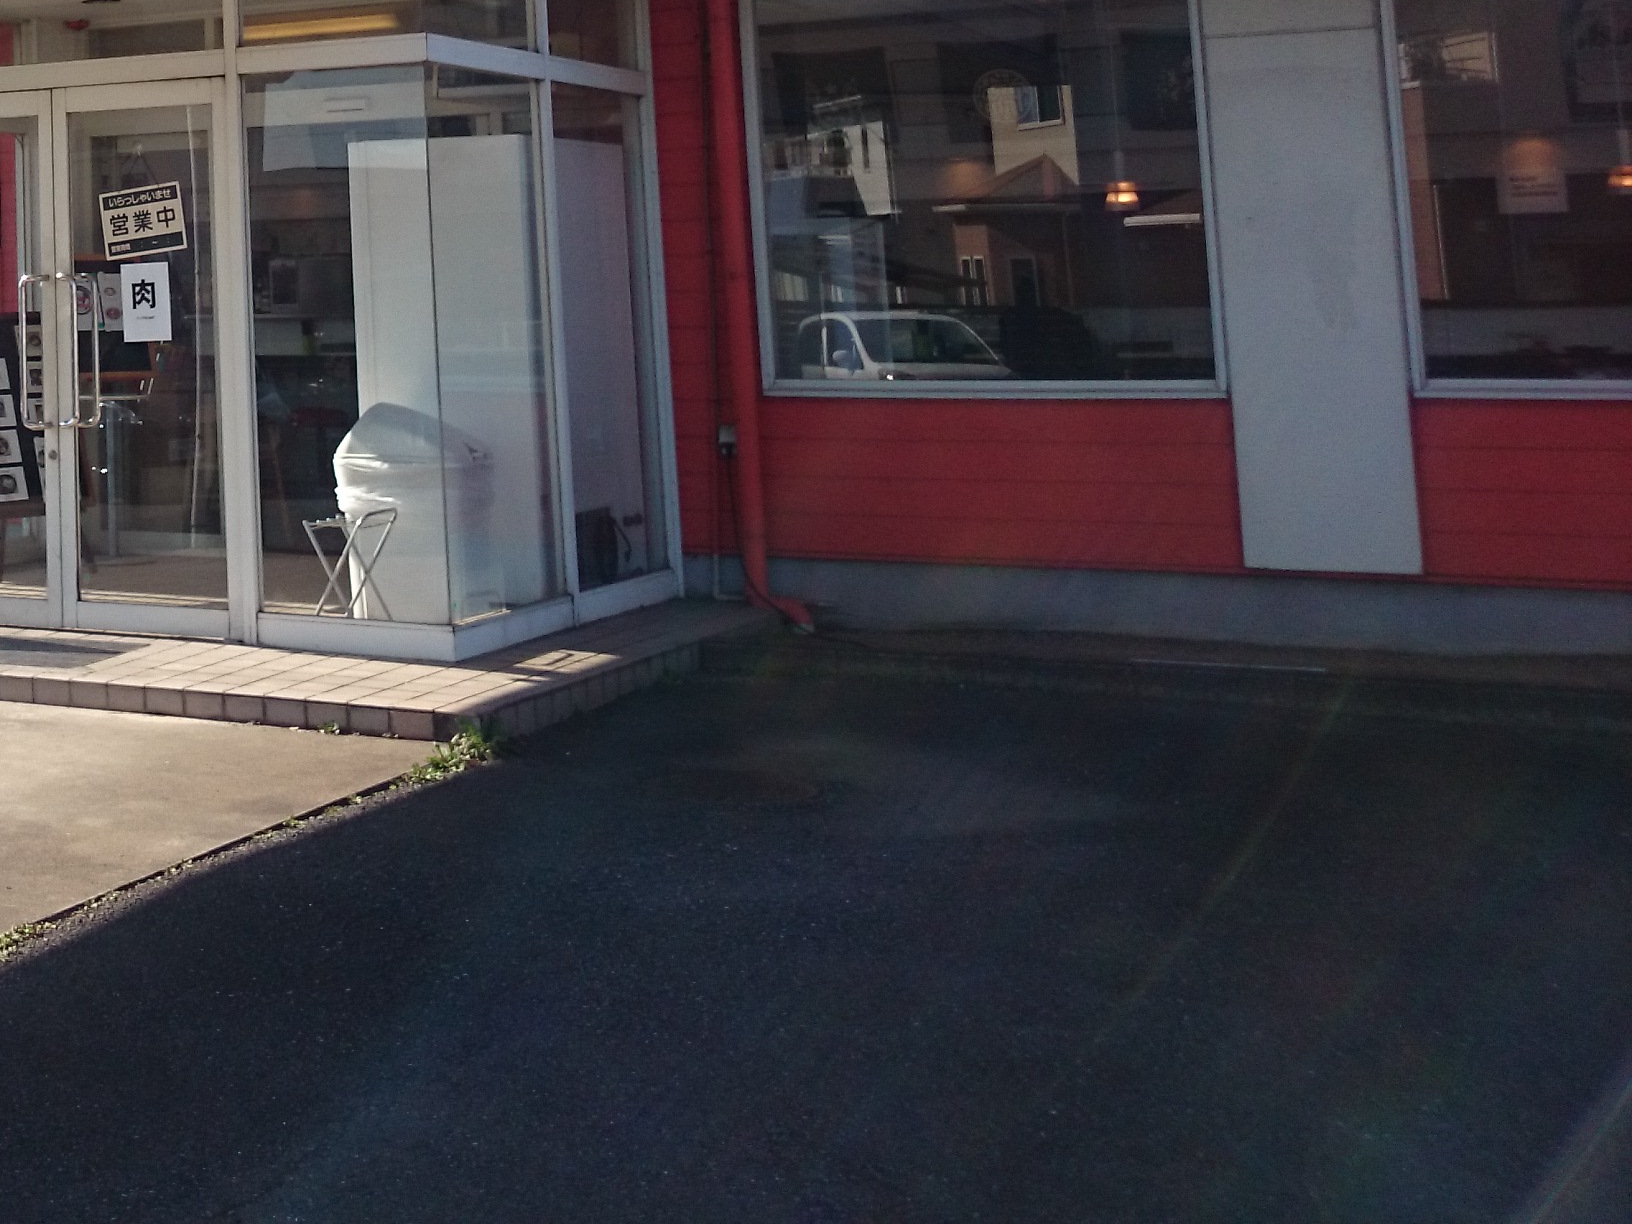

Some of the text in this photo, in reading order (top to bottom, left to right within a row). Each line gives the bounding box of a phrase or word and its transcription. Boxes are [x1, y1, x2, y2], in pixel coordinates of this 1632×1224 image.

[108, 189, 172, 208] いらっしゃいませ
[109, 206, 176, 237] 営業中
[131, 279, 156, 309] 肉
